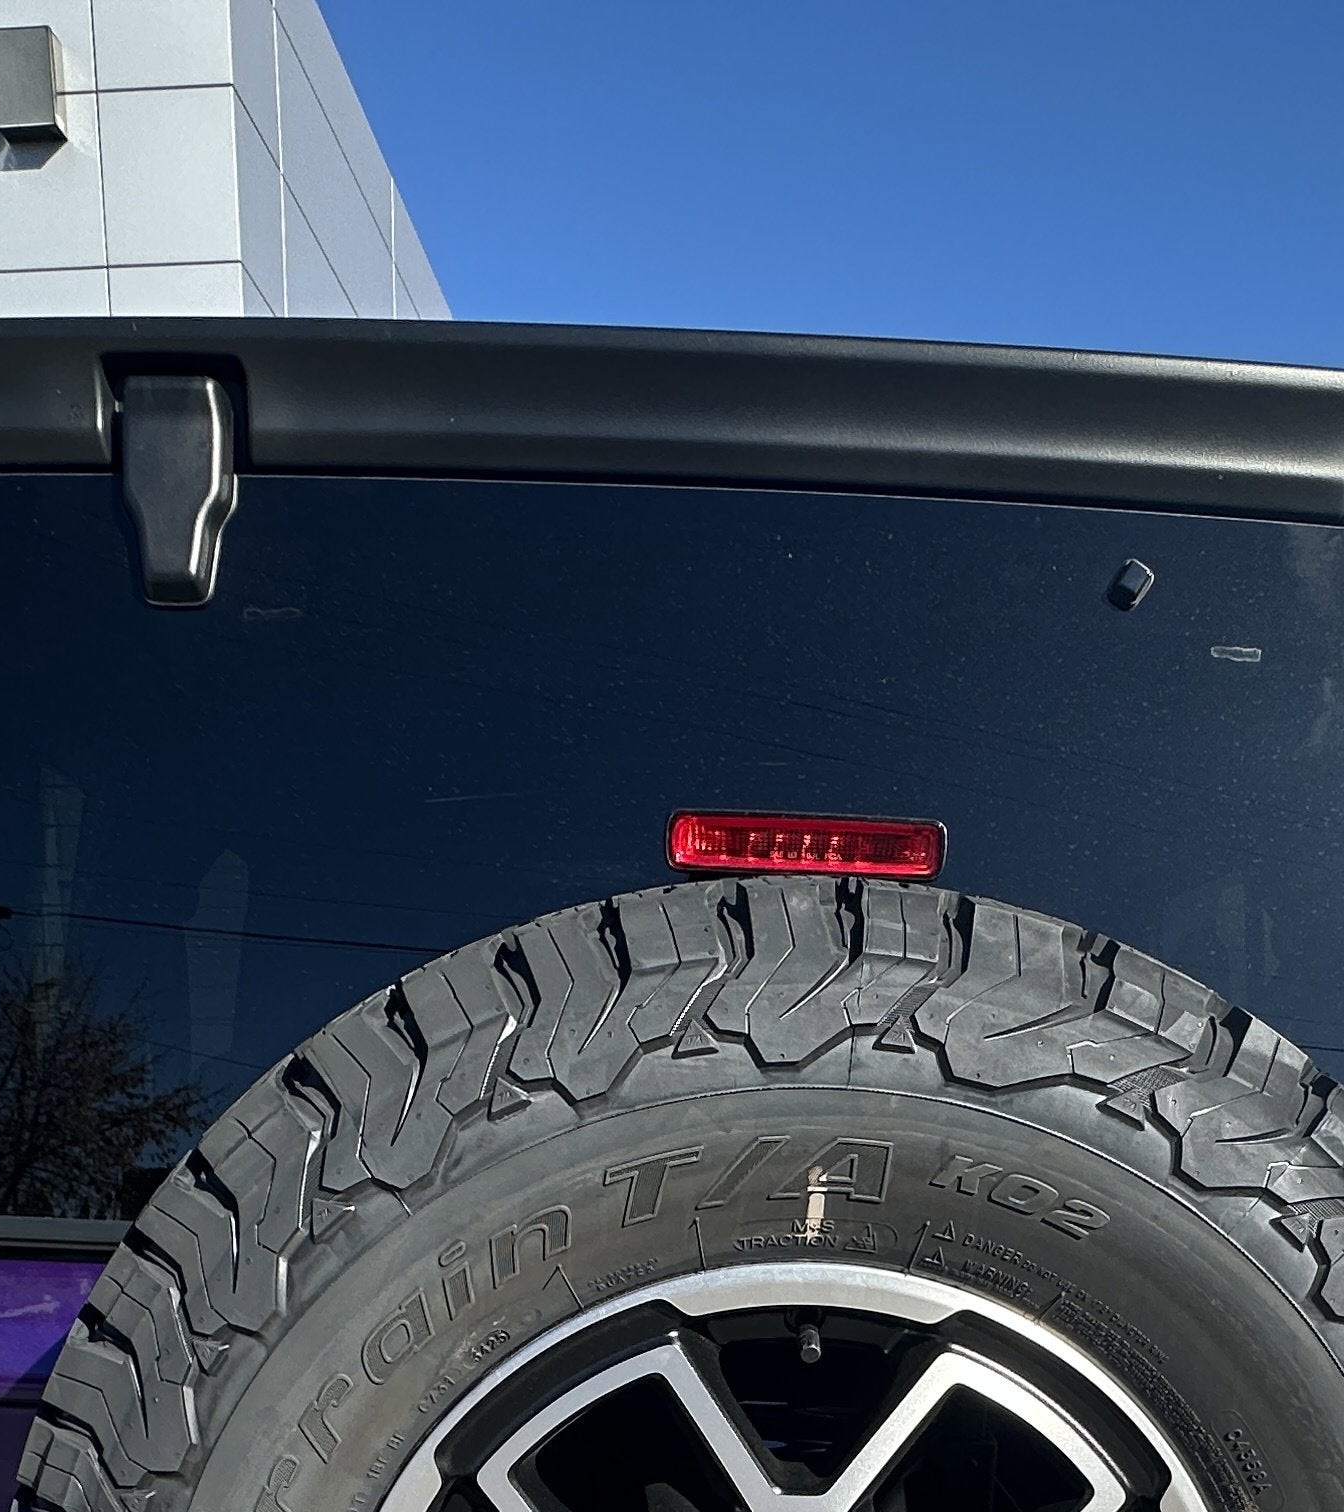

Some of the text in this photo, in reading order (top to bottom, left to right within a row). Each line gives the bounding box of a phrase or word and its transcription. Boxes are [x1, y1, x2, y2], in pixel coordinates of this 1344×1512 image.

[602, 1134, 897, 1228] T/A
[927, 1154, 1113, 1241] KO2
[738, 1234, 837, 1250] TRACTION
[960, 1230, 1025, 1268] DANGER
